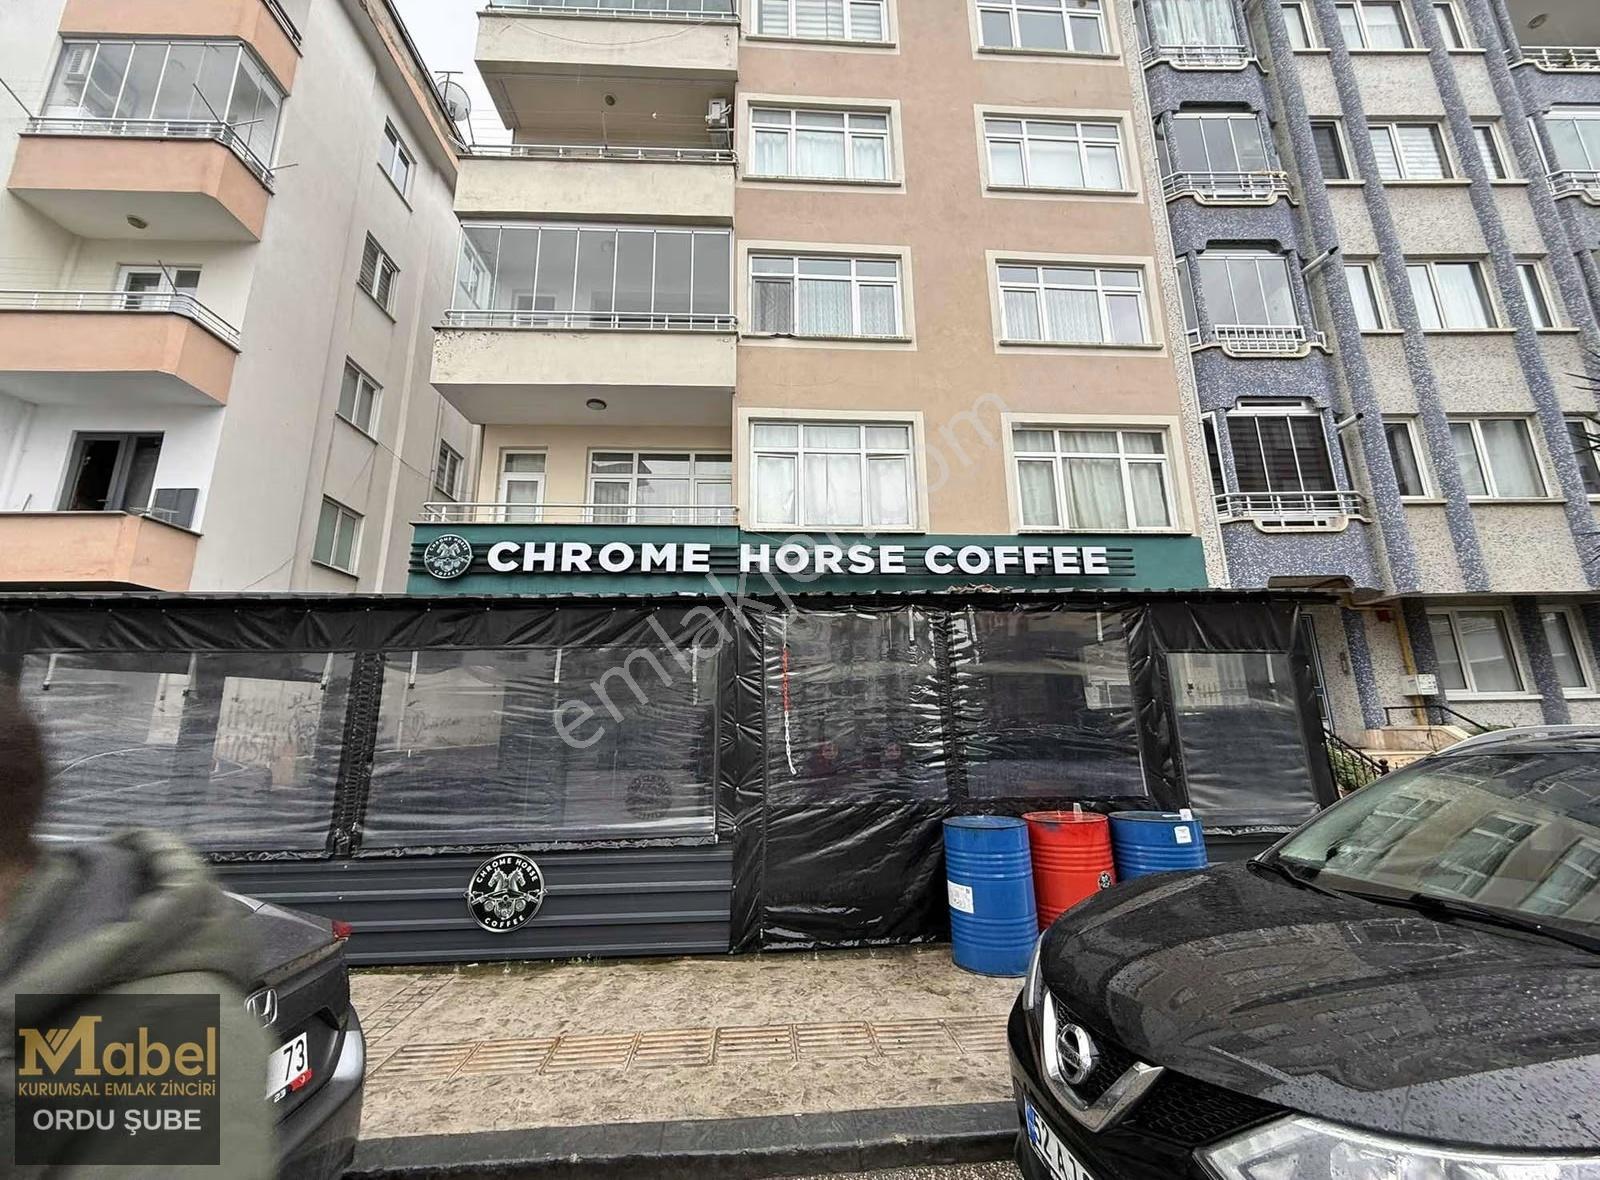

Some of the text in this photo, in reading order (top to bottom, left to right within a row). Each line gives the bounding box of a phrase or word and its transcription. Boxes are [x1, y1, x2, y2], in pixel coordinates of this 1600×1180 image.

[487, 541, 1110, 575] CHROME HORSE COFFEE
[476, 857, 538, 883] CHROME HORSE
[484, 915, 525, 928] COFFEE
[283, 1039, 305, 1082] 73
